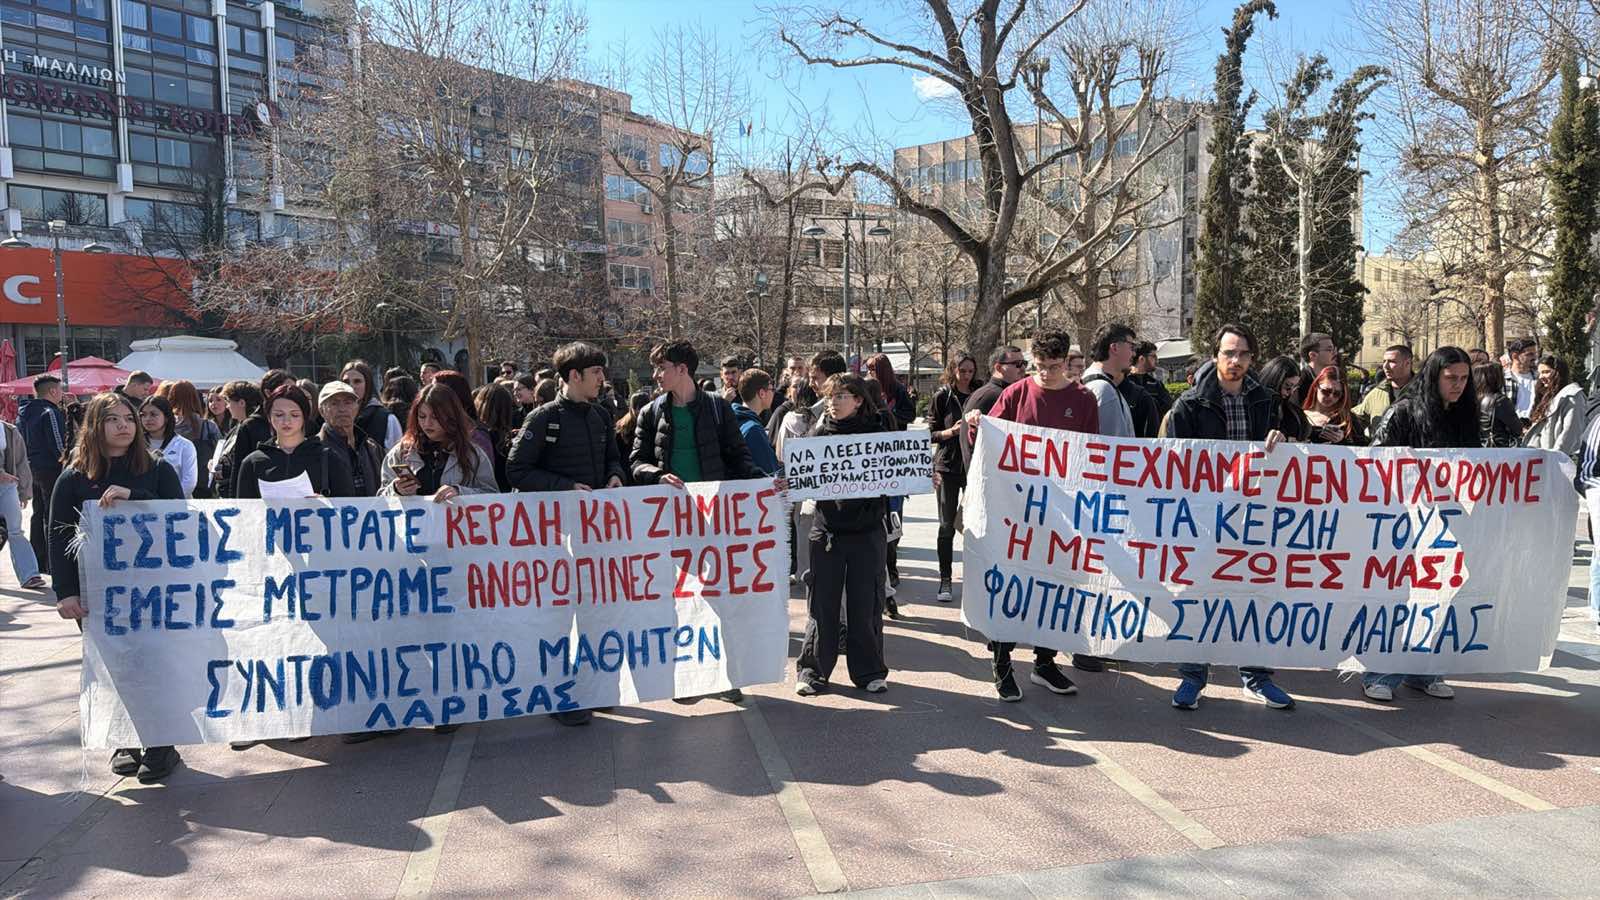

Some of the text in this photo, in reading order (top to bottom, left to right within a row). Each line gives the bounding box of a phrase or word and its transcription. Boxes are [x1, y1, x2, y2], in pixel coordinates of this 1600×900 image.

[33, 55, 126, 83] ΜΑΛΛΙΩΝ
[790, 449, 815, 463] ΝΑ
[790, 465, 814, 476] ΔΕΝ
[820, 460, 855, 473] ΕΧΩ
[896, 467, 932, 478] ΚΡΑΤΟΣ
[998, 433, 1069, 478] ΔΕΝ
[1355, 457, 1543, 506] ΣΥΓΧΩΡΟΥΜΕ
[103, 489, 777, 570] ΕΣΕΙΣ ΜΕΤΡΑΤΕ ΚΕΡΔΗ ΚΑΙ ΖΗΜΙΕΣ
[1074, 490, 1129, 534] ΜΕ
[1146, 497, 1198, 538] ΤΑ
[1215, 501, 1340, 550] ΚΕΡΔΗ
[1366, 505, 1462, 550] ΤΟΥΣ
[104, 540, 776, 635] ΕΜΕΙΣ ΜΕΤΡΑΜΕ ΑΝΘΡΩΠΙΝΕΣ ΖΩΕΣ
[1047, 530, 1105, 574] ΜΕ
[1127, 540, 1195, 586] ΤΙΣ
[1211, 546, 1350, 589] ΖΩΕΣ
[1363, 551, 1465, 590] ΜΑΣ!
[984, 563, 1493, 654] ΦΟΙΤΗΤΙΚΟΙ ΣΥΛΛΟΓΟΙ ΛΑΡΙΣΑΣ
[205, 625, 720, 718] ΣΥΝΤΟΝΙΣΤΙΚΟ ΜΑΘΗΤΩΝ
[365, 680, 580, 728] ΛΑΡΙΣΑΣ
